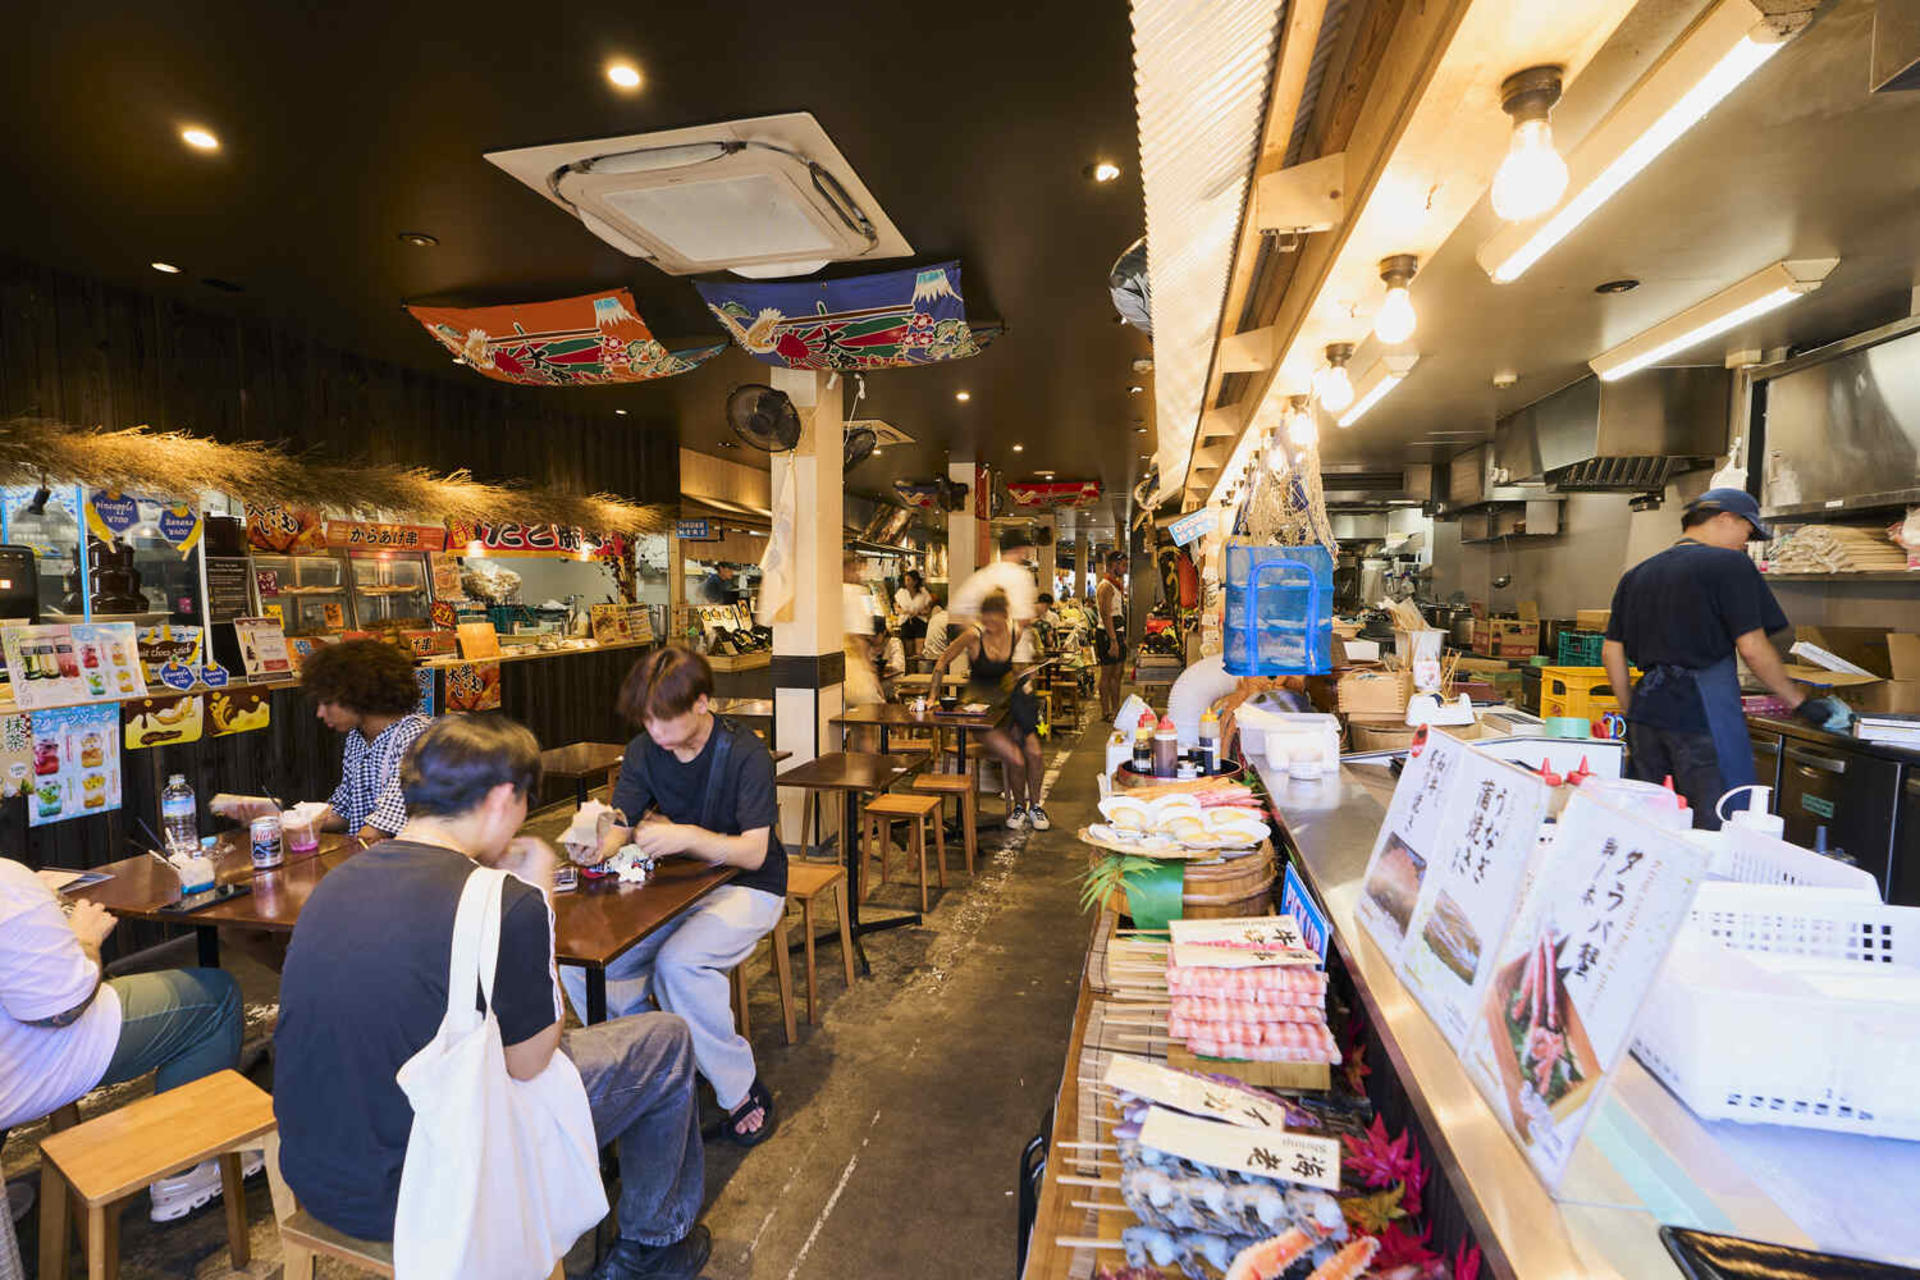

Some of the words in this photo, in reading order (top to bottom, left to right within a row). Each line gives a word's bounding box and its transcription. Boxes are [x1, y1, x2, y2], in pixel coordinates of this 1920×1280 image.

[350, 529, 419, 546] からあげ串
[1246, 1146, 1327, 1180] 海老
